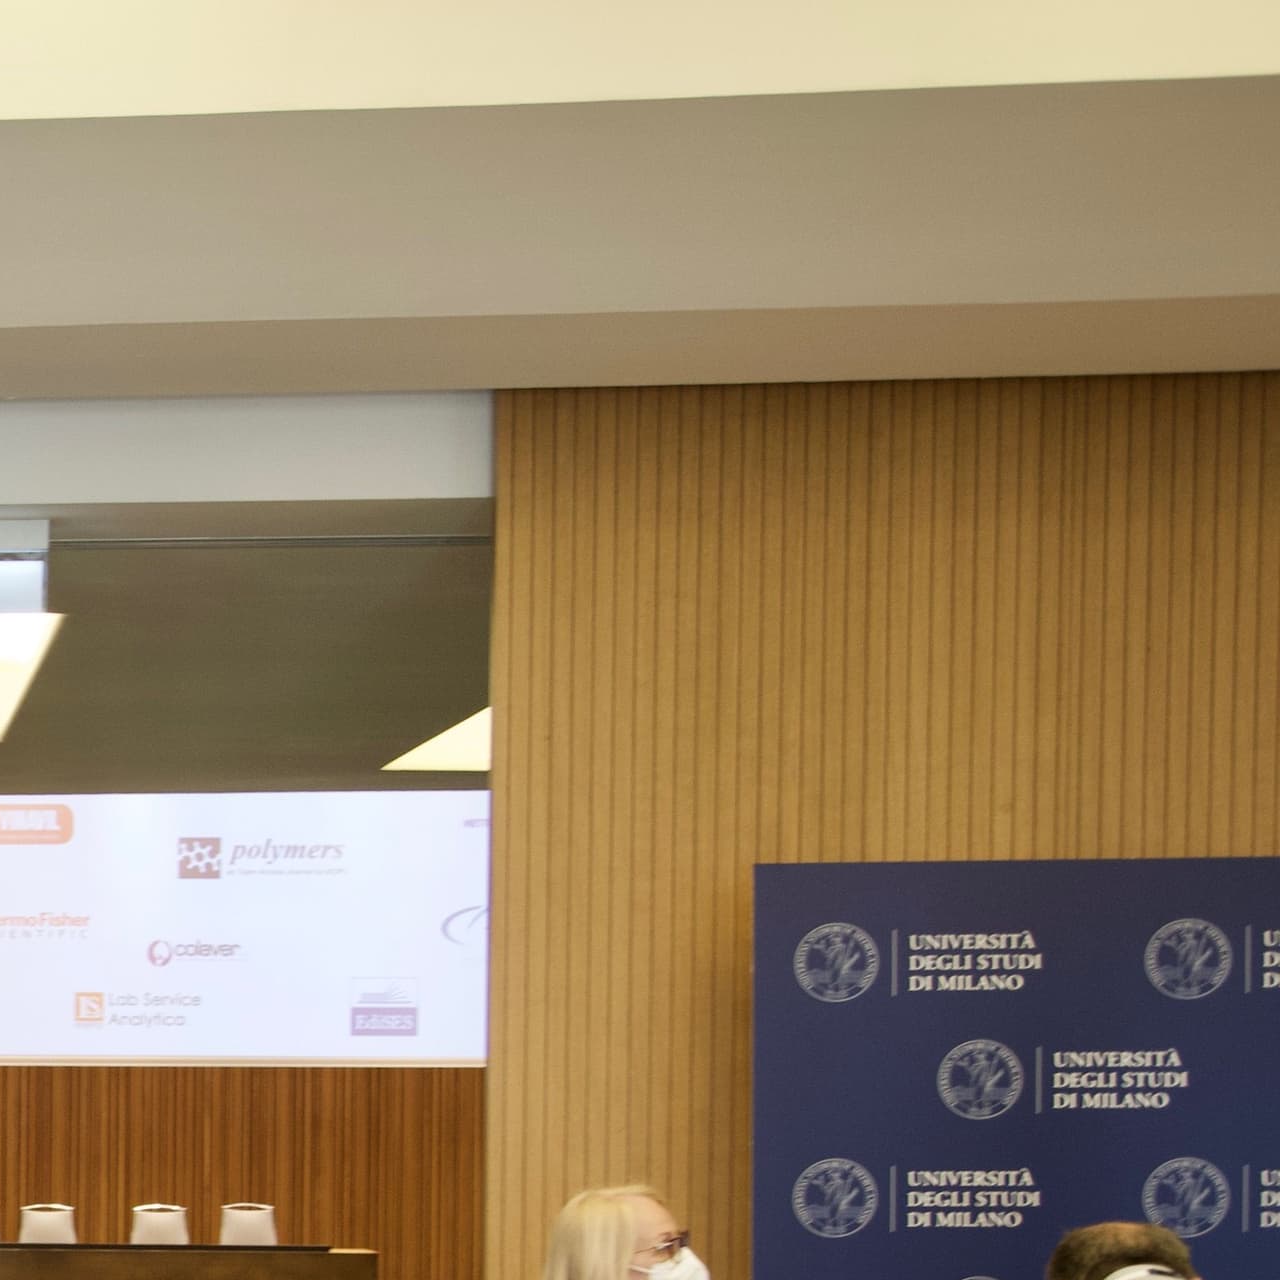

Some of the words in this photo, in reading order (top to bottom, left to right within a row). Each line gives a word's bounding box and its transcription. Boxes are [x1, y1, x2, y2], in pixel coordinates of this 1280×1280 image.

[229, 838, 345, 865] polymers
[908, 931, 1036, 950] UNIVERSITÀ
[908, 954, 973, 970] DEGLI
[976, 954, 1043, 970] STUDI
[908, 975, 934, 991] DI
[936, 975, 1025, 991] MILANO
[1053, 1048, 1182, 1067] UNIVERSITÀ
[1053, 1072, 1117, 1088] DEGLI
[1121, 1072, 1188, 1088] STUDI
[1053, 1092, 1078, 1108] DI
[1081, 1092, 1171, 1108] MILANO
[907, 1168, 1035, 1186] UNIVERSITÀ
[907, 1191, 971, 1207] DEGLI
[974, 1191, 1041, 1207] STUDI
[907, 1212, 932, 1227] DI
[935, 1212, 1023, 1227] MILANO
